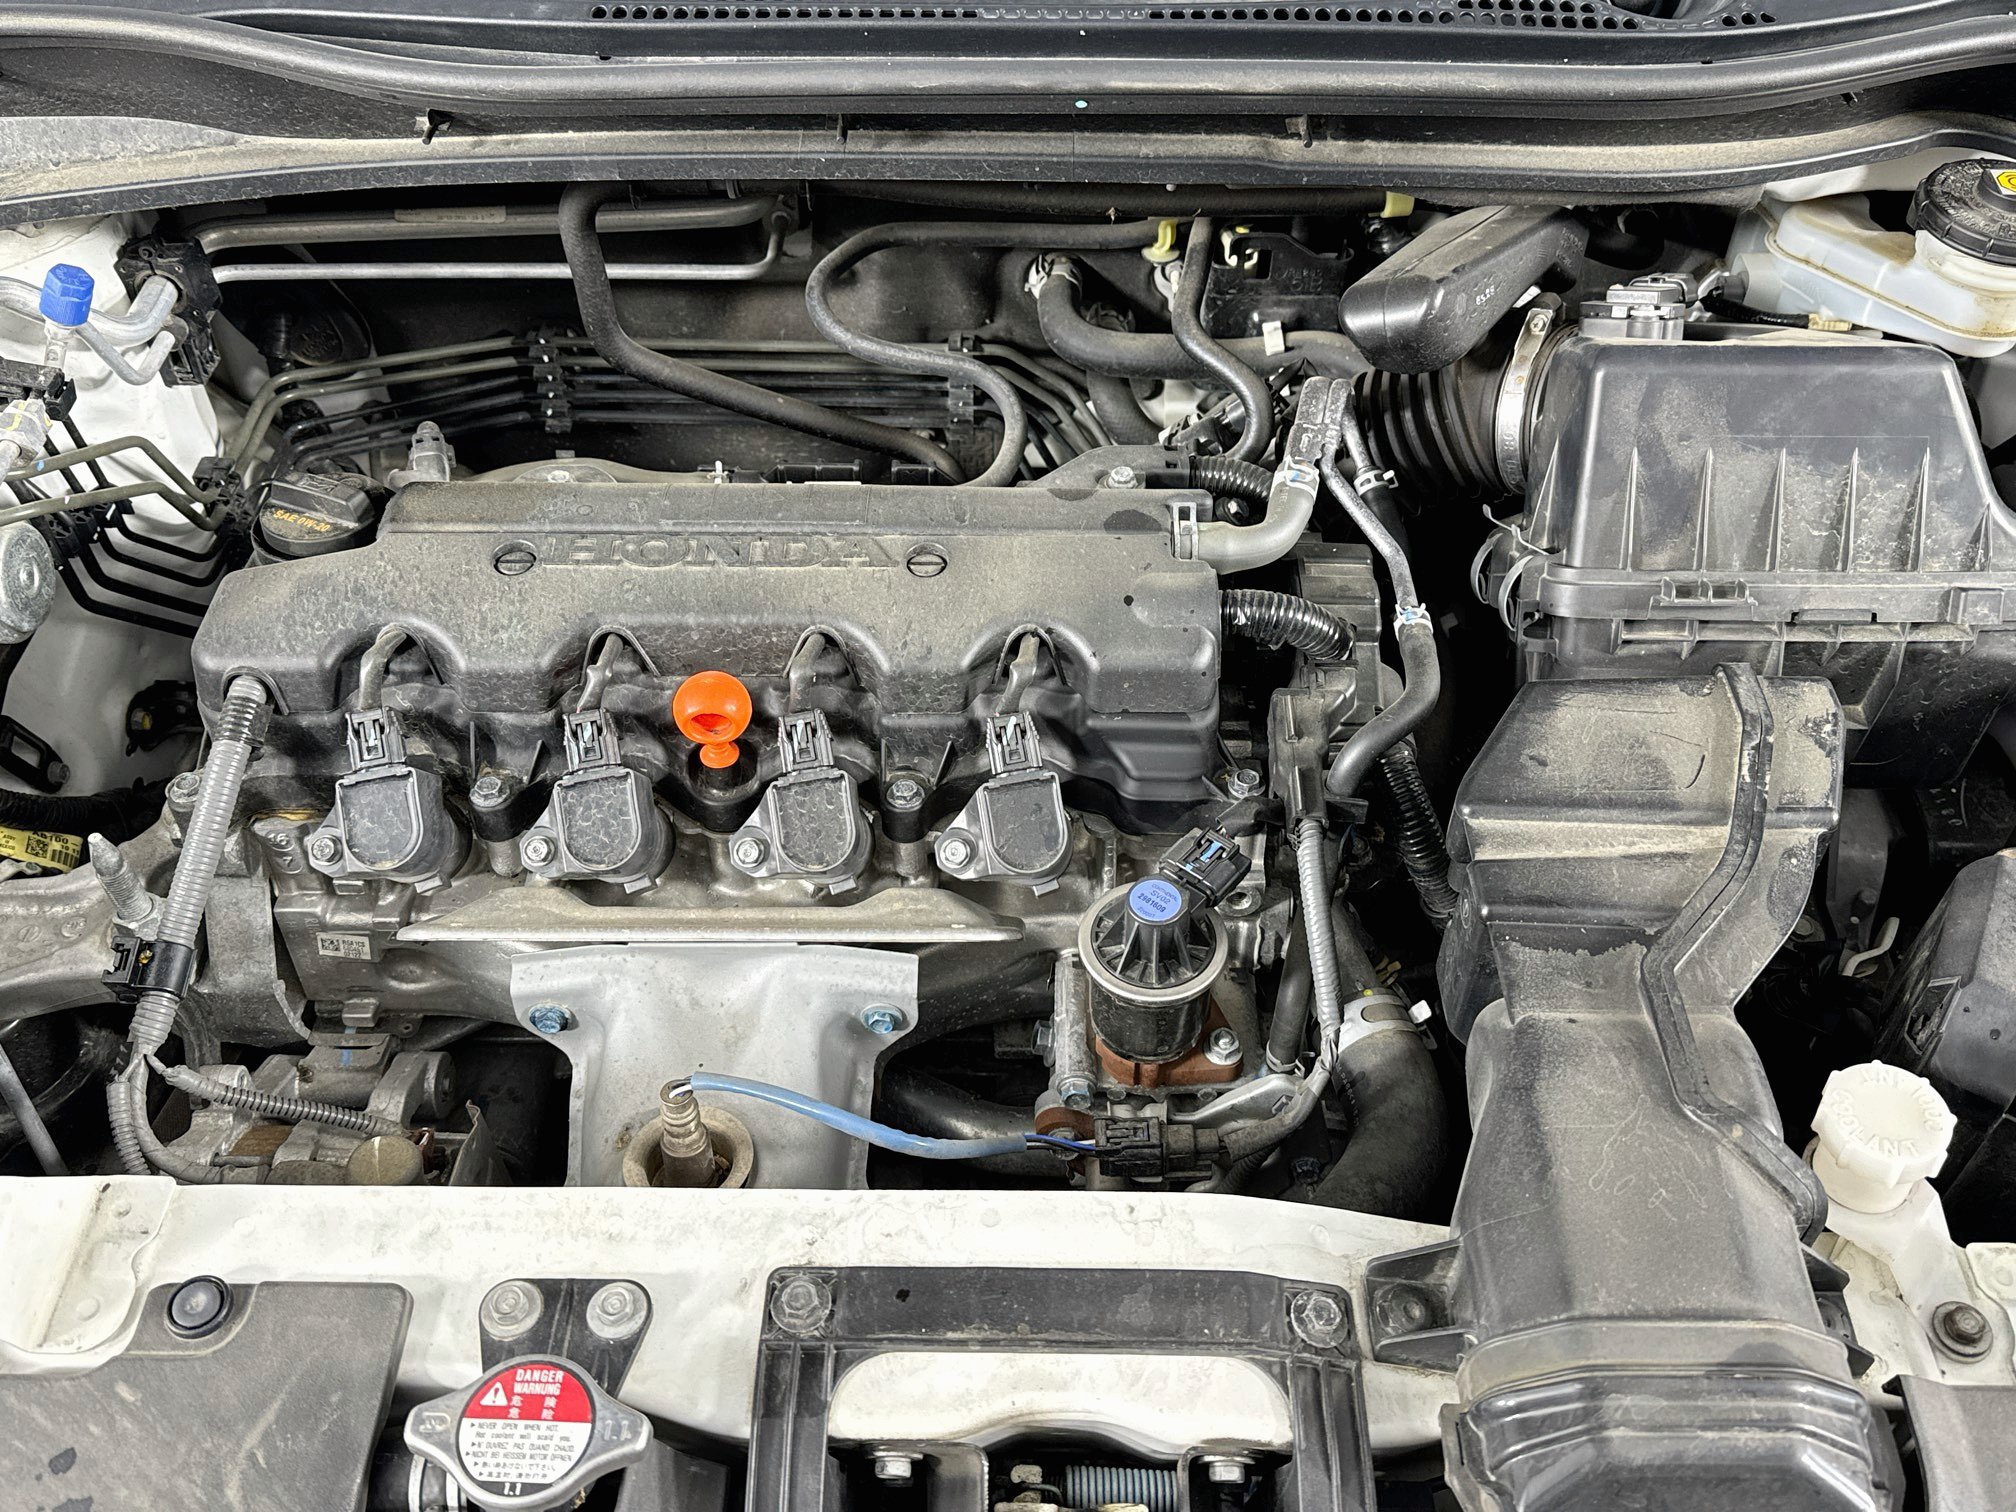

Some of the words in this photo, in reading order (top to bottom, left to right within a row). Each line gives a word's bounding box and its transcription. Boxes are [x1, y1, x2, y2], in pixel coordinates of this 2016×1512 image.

[273, 510, 297, 523] SAE
[298, 517, 330, 531] 0W-20
[541, 535, 900, 568] HONDA
[1151, 890, 1170, 905] SV02
[1830, 1087, 1919, 1158] COOLANT
[515, 1368, 565, 1384] DANGER
[513, 1381, 562, 1396] WARNUNG
[477, 1422, 498, 1431] NEVER
[501, 1422, 518, 1431] OPEN
[523, 1423, 541, 1432] WHEN
[491, 1432, 515, 1440] coolant
[537, 1433, 554, 1442] scald
[528, 1443, 551, 1452] QUAND
[471, 1450, 489, 1459] NICHT
[490, 1451, 501, 1459] BEI
[502, 1451, 527, 1460] HEISSEN
[529, 1452, 549, 1461] MOTOR
[503, 1482, 522, 1496] 1.1
